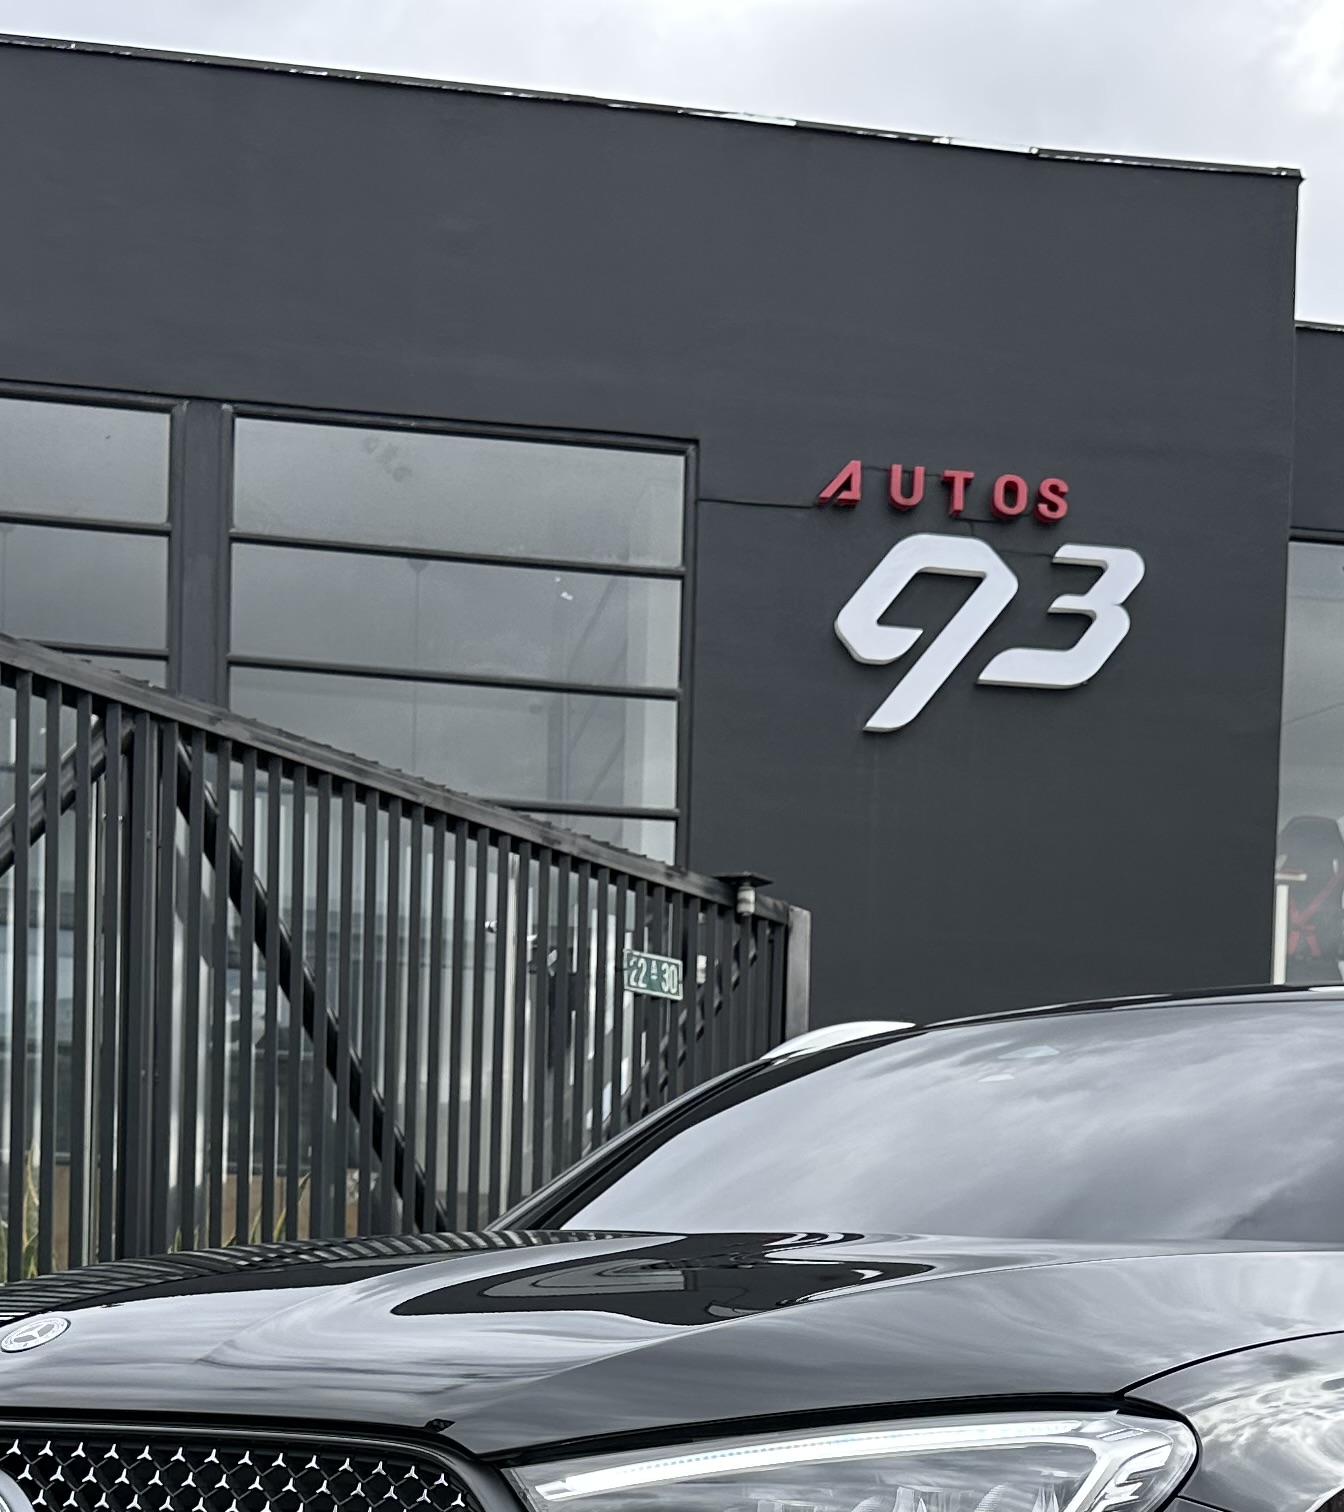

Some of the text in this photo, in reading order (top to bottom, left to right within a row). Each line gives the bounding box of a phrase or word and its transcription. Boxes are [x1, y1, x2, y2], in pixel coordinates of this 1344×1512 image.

[817, 459, 1070, 524] AUTOS
[834, 532, 1146, 733] 93
[661, 962, 678, 994] 30
